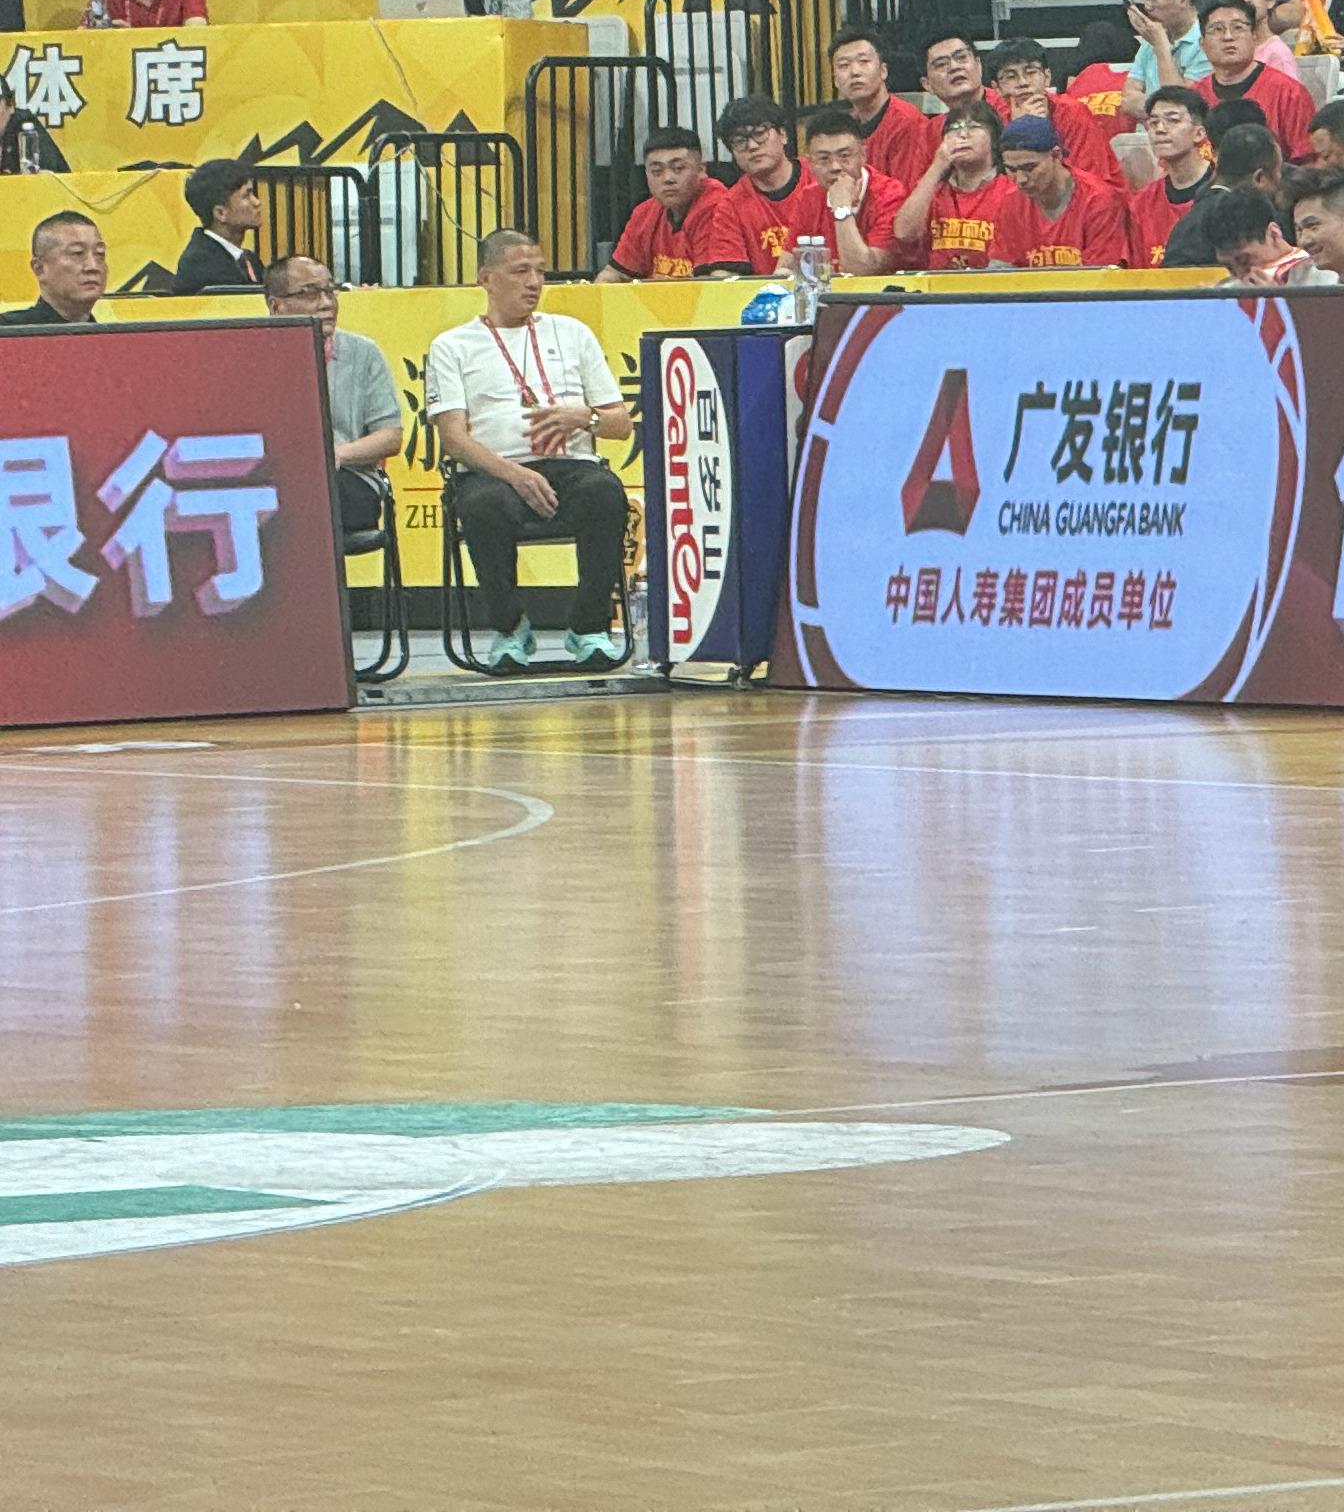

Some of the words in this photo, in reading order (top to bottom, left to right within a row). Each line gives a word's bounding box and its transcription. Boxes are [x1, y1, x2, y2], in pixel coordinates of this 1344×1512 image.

[3, 39, 207, 128] 体席
[1003, 377, 1202, 486] 广发银行
[696, 387, 723, 580] 百岁山
[998, 500, 1051, 537] CHINA
[1055, 500, 1138, 537] GUANGFA
[1139, 501, 1187, 537] BANK
[884, 565, 1178, 631] 中国人寿集团成员单位
